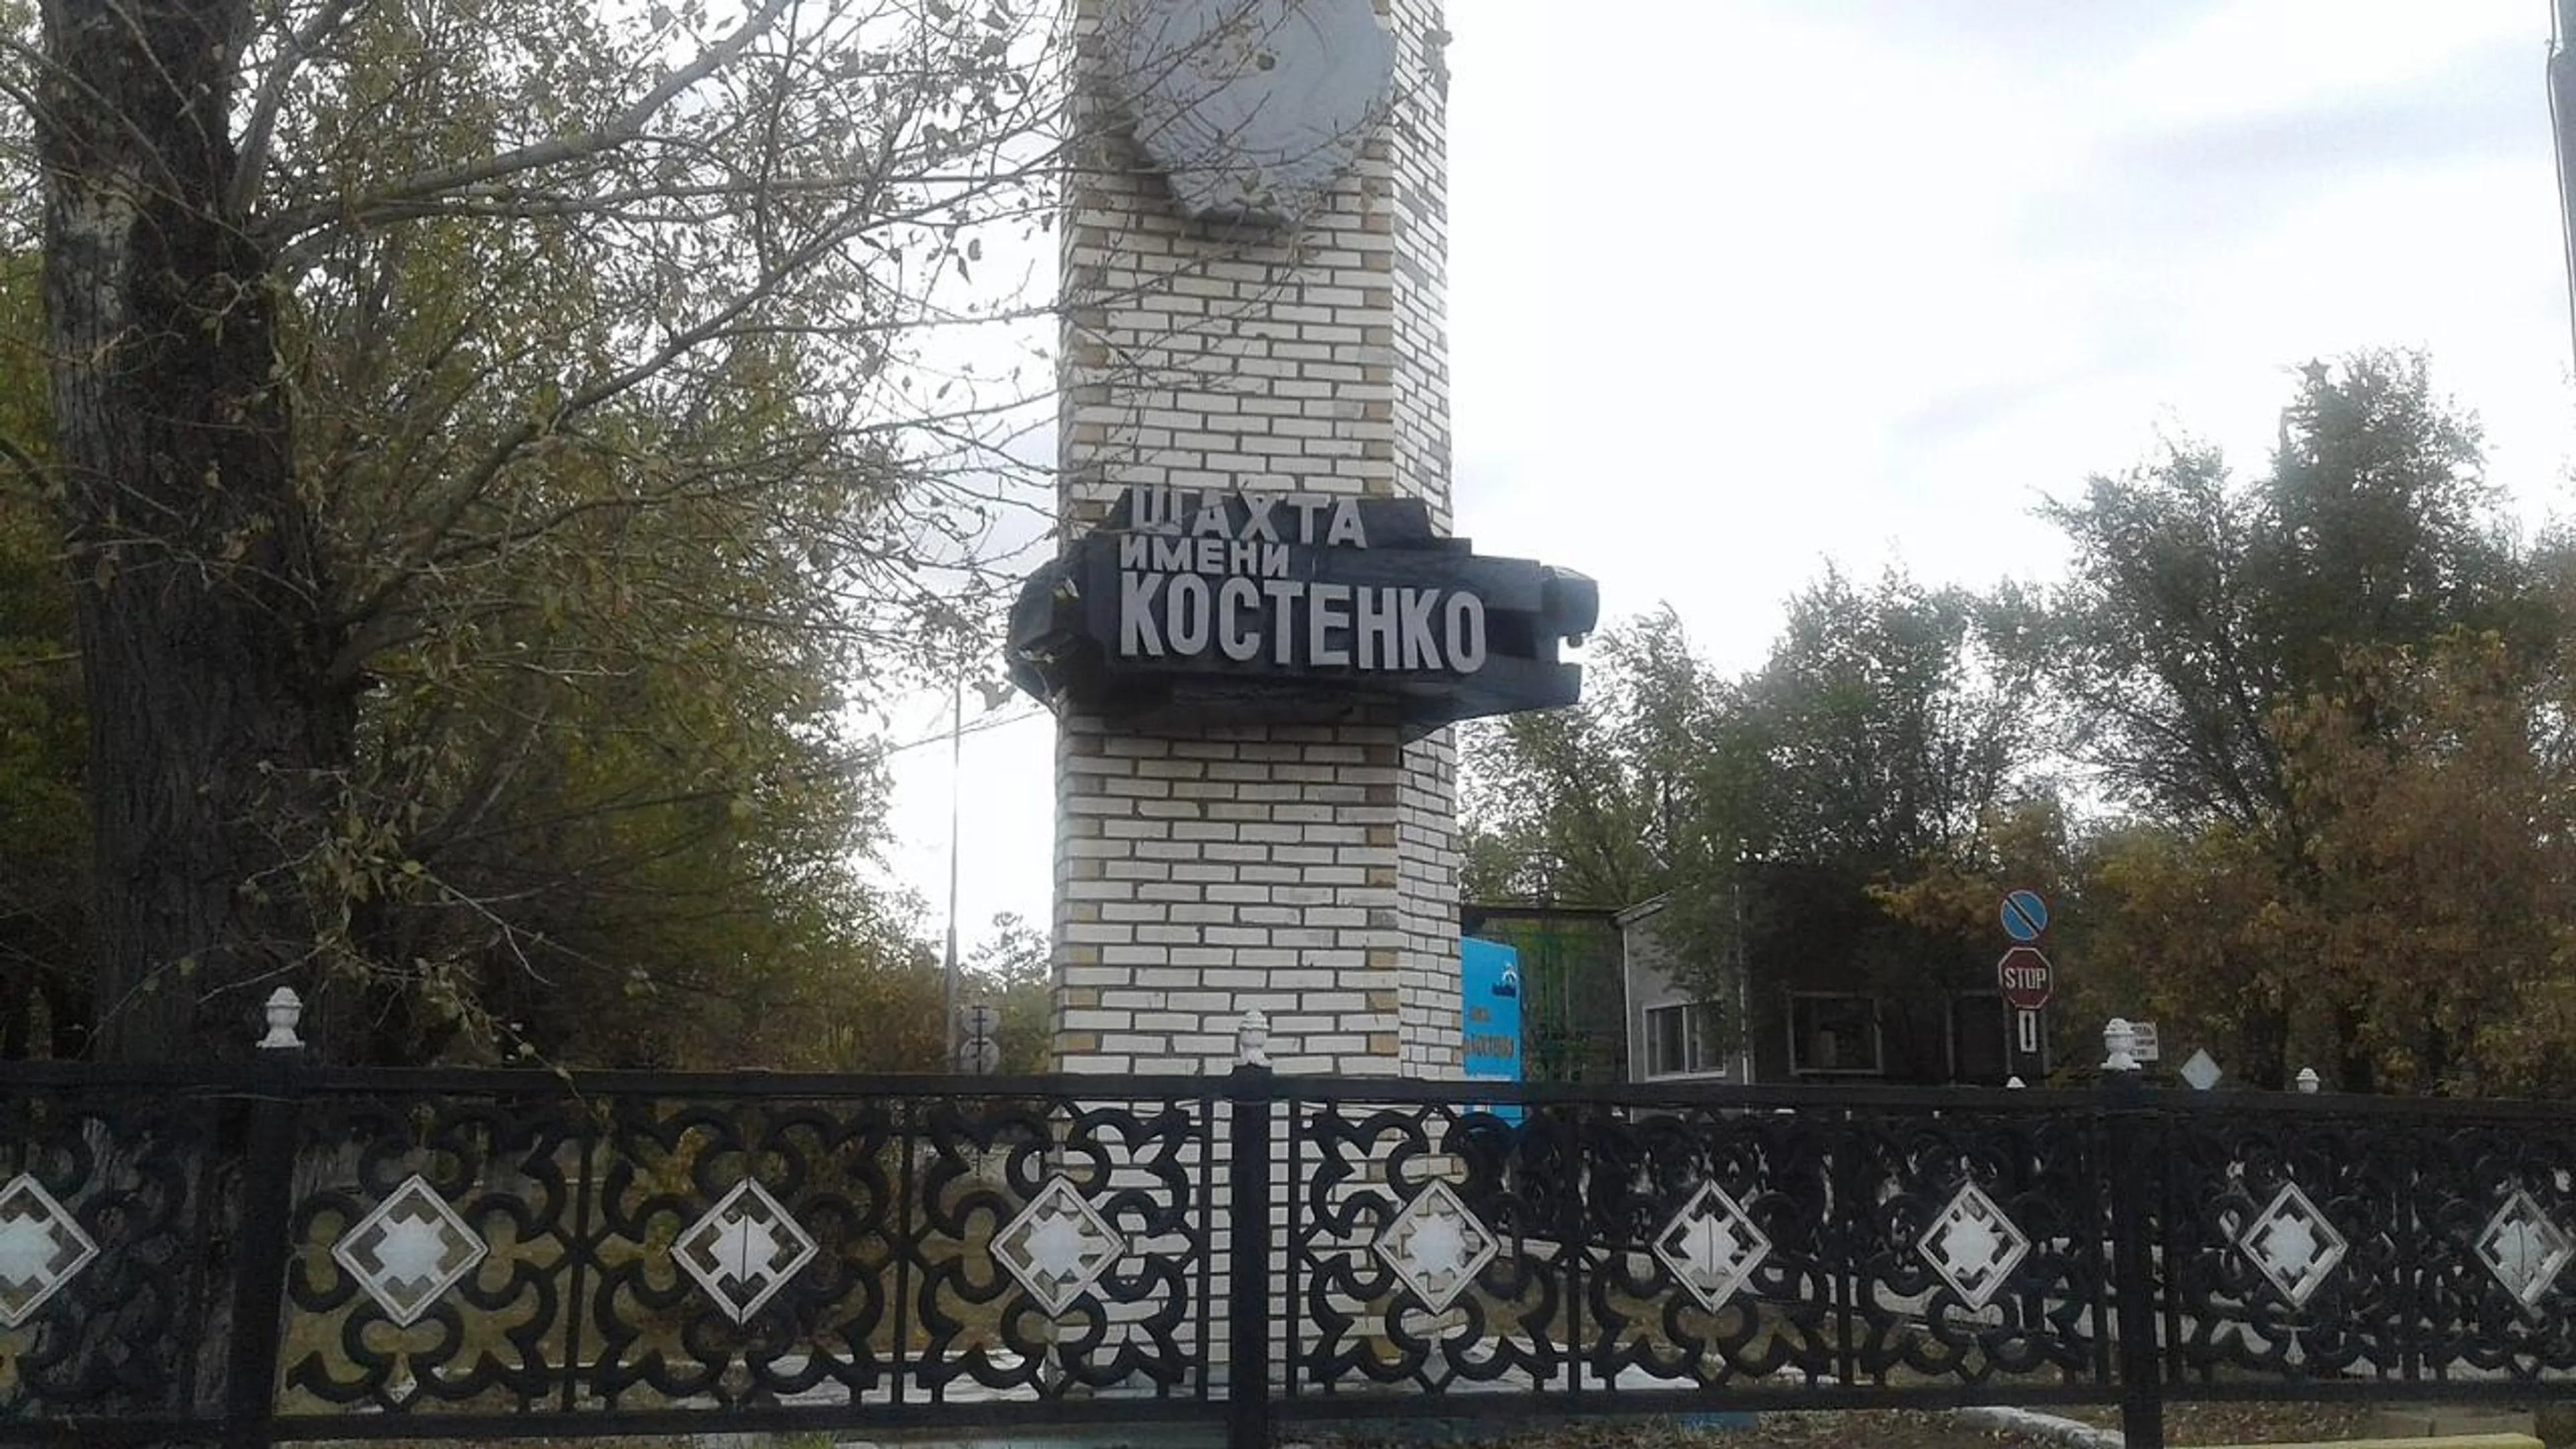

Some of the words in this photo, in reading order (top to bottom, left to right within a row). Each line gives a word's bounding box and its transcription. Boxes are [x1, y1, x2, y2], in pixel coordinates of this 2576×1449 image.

[1131, 483, 1368, 549] ШАХТА
[1120, 535, 1289, 578] ИМЕНИ
[1120, 570, 1487, 674] КОСТЕНКО
[2004, 967, 2046, 990] STOP
